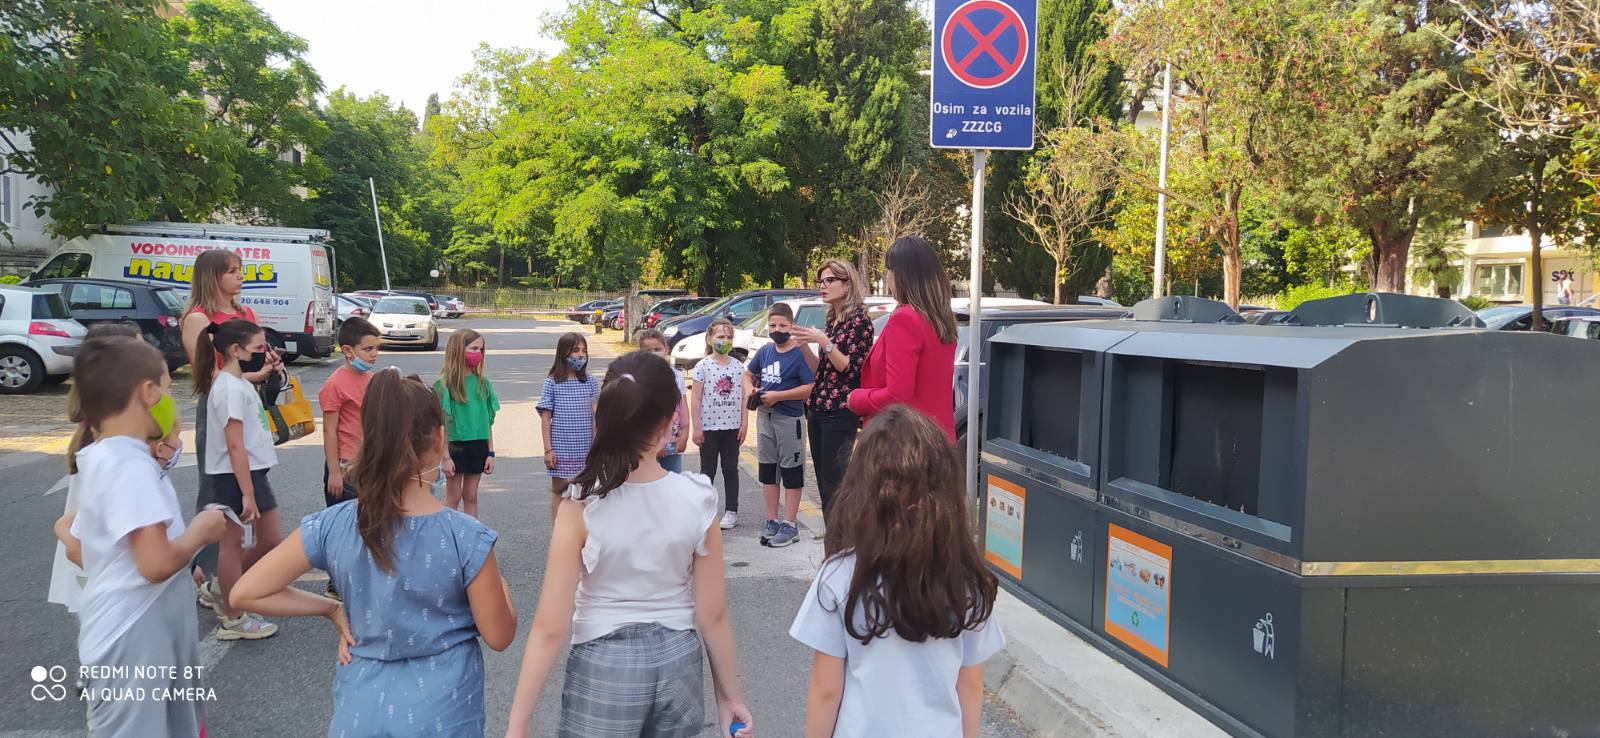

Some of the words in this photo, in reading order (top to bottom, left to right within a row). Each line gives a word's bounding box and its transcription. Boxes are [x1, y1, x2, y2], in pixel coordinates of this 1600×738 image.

[933, 102, 964, 114] Osim
[972, 105, 987, 115] za
[995, 104, 1032, 116] vozila
[961, 121, 1002, 132] ZZZCG
[130, 242, 271, 260] VODOINSATER
[128, 257, 275, 284] nauus
[272, 298, 290, 306] 904
